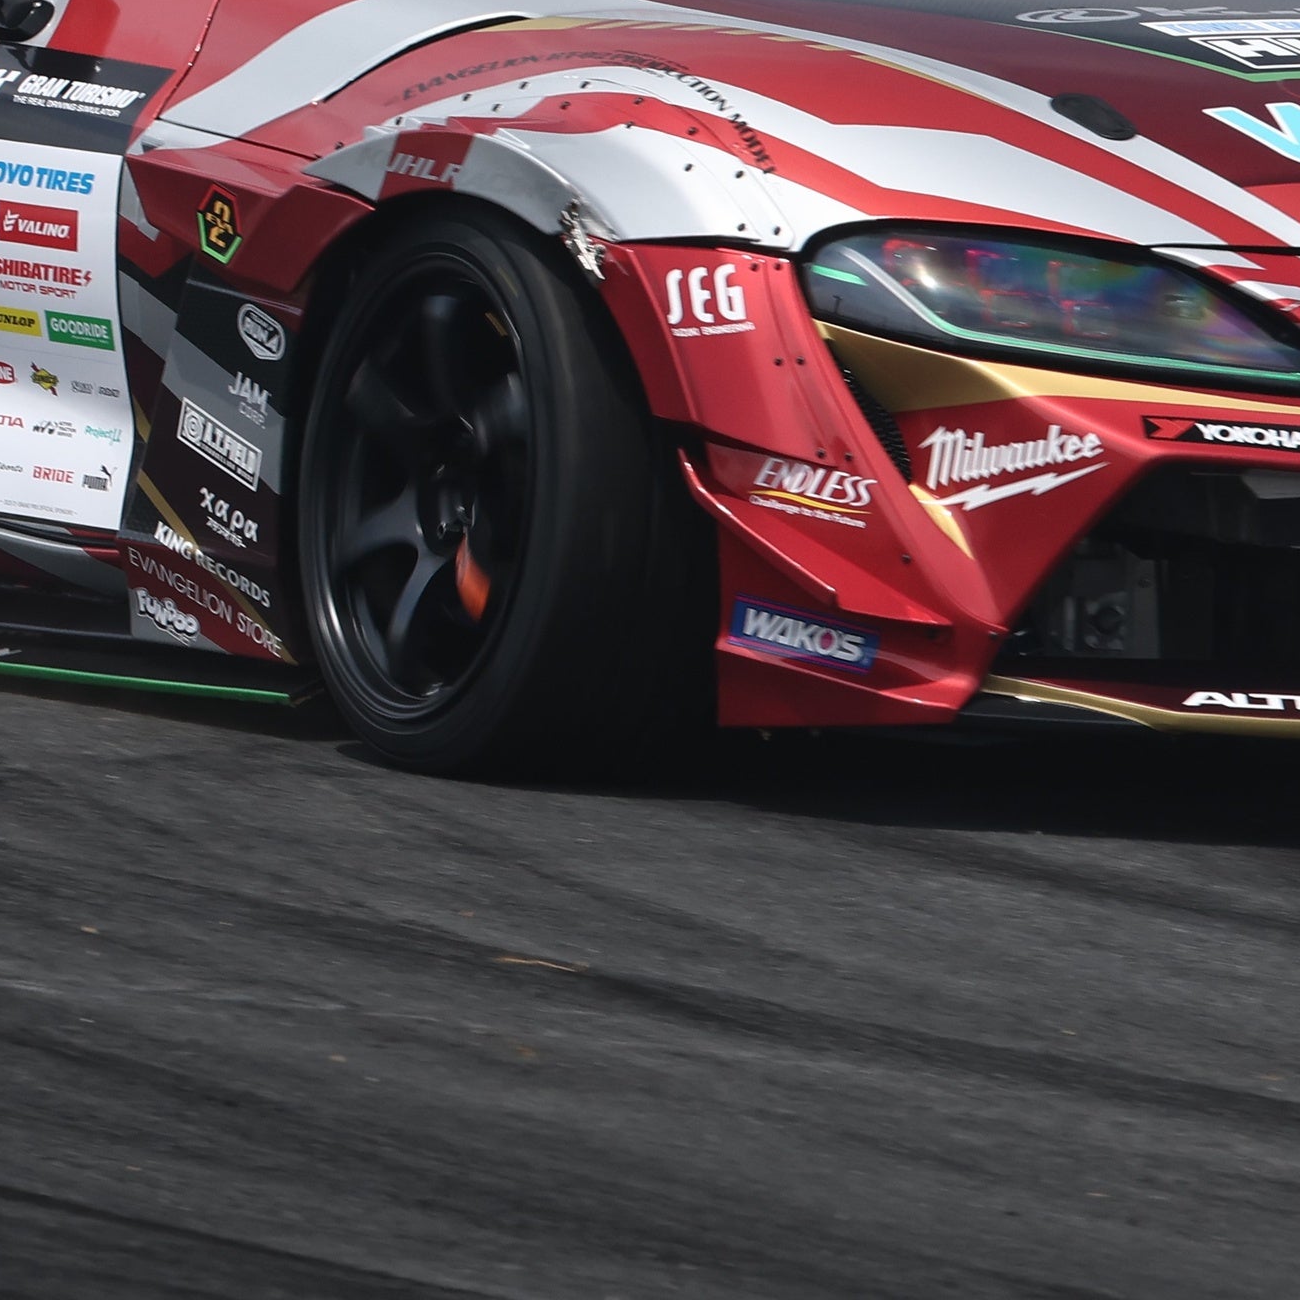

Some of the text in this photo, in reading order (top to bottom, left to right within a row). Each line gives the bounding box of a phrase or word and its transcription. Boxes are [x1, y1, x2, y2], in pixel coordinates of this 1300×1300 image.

[17, 74, 70, 98] GRAN
[35, 166, 95, 194] TIRES
[17, 218, 71, 239] VALINO
[0, 280, 78, 299] MOTOR SPORT
[49, 317, 109, 340] GOODRIDE
[228, 371, 269, 416] JAM
[919, 424, 1104, 490] Milwaukee
[32, 465, 75, 484] BRIDE
[81, 473, 109, 492] PUMA
[753, 457, 878, 507] ENDLESS
[153, 520, 194, 561] KING
[194, 548, 271, 608] RECORDS
[127, 546, 283, 659] EVANGELION STORE
